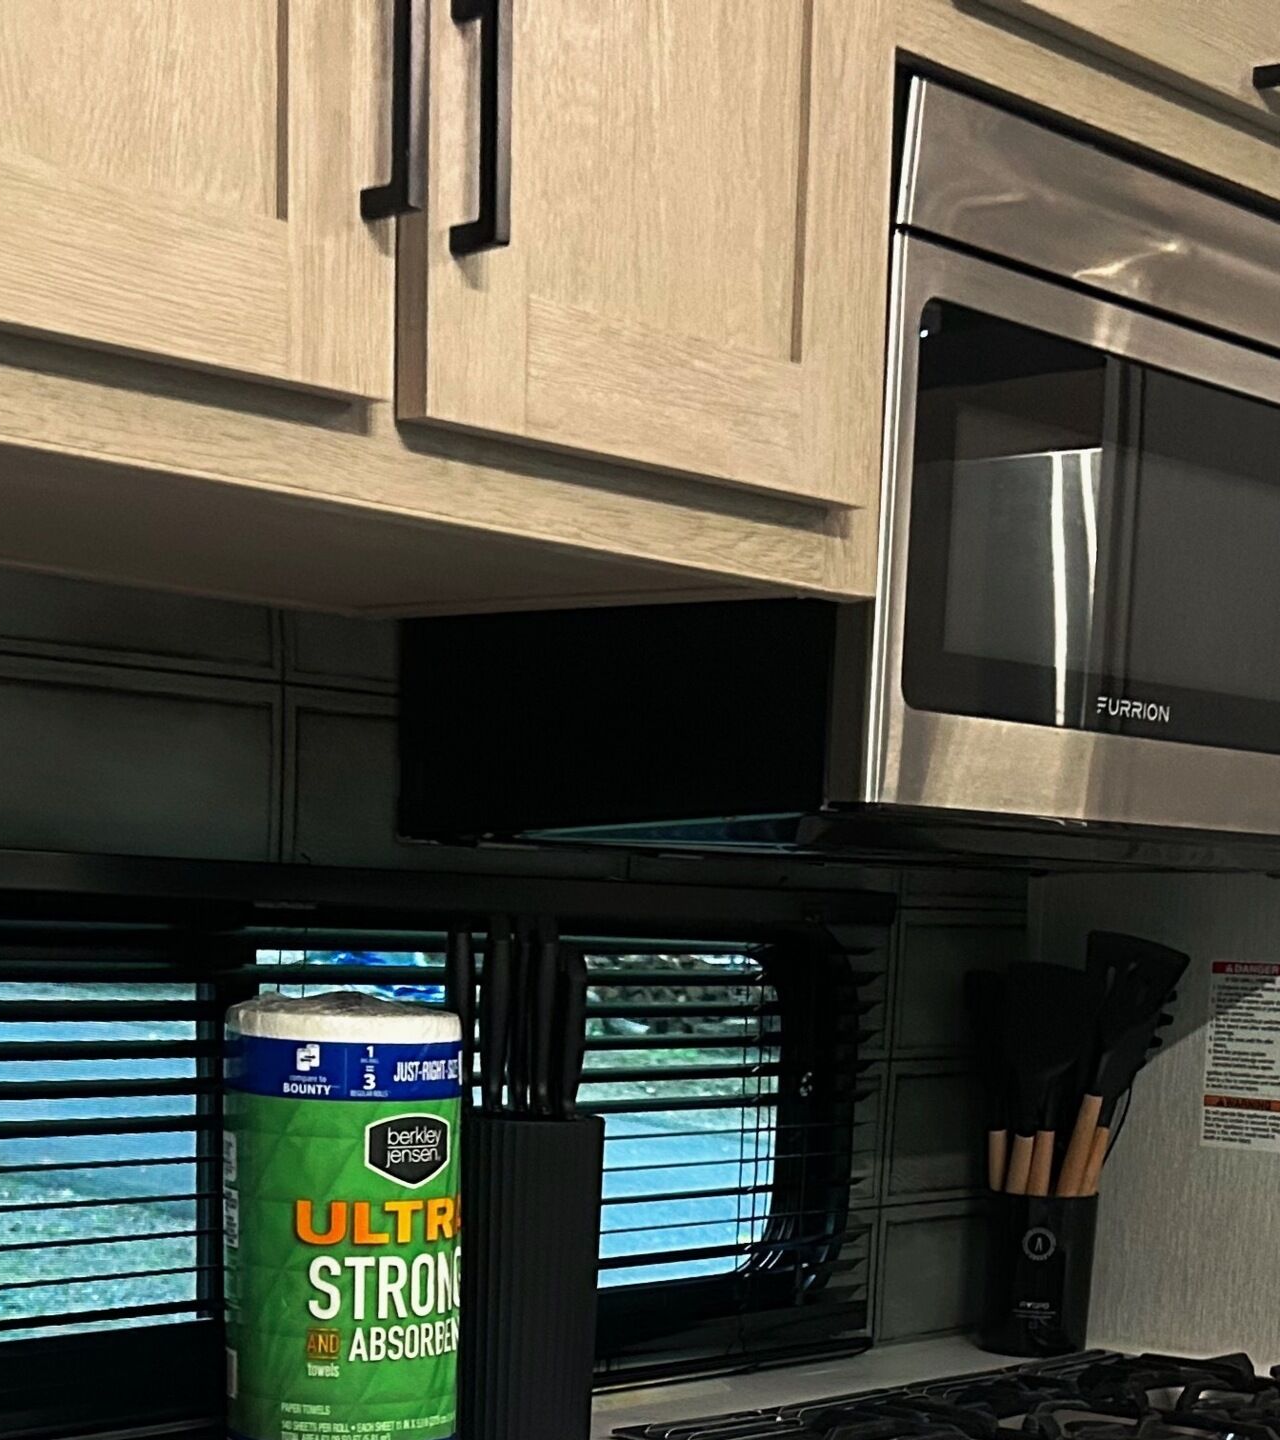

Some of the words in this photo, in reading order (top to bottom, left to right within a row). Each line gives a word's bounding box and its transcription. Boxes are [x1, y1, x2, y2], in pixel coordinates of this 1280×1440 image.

[1097, 696, 1170, 722] FURRION
[366, 1045, 374, 1058] 1
[283, 1082, 331, 1096] BOUNTY
[363, 1073, 376, 1090] 3
[387, 1126, 442, 1147] berkley
[385, 1148, 438, 1168] jensen
[307, 1333, 340, 1354] AND
[348, 1317, 460, 1362] ABSORBEN
[307, 1362, 340, 1377] towels
